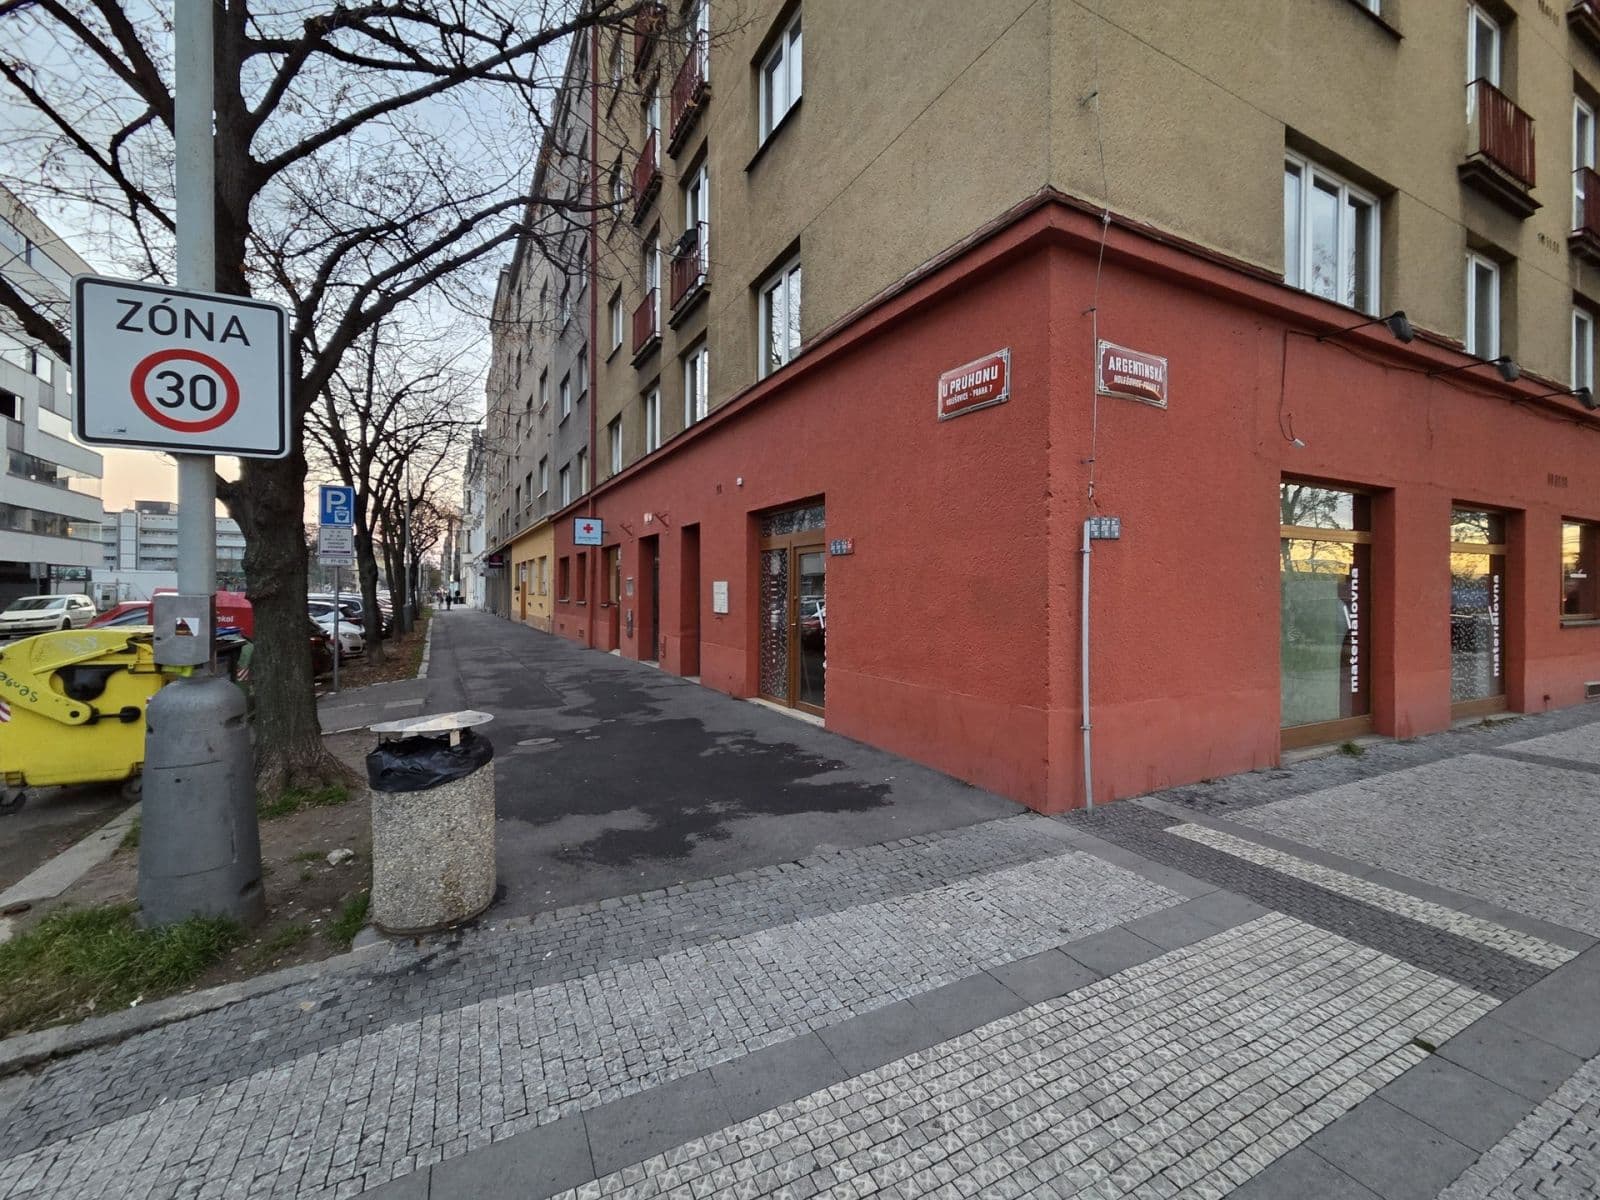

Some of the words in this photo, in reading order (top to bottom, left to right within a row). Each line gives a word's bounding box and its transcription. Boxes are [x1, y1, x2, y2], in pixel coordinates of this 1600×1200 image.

[116, 298, 250, 346] ZÓNA
[155, 370, 217, 411] 30
[942, 383, 948, 397] U
[326, 490, 346, 513] P
